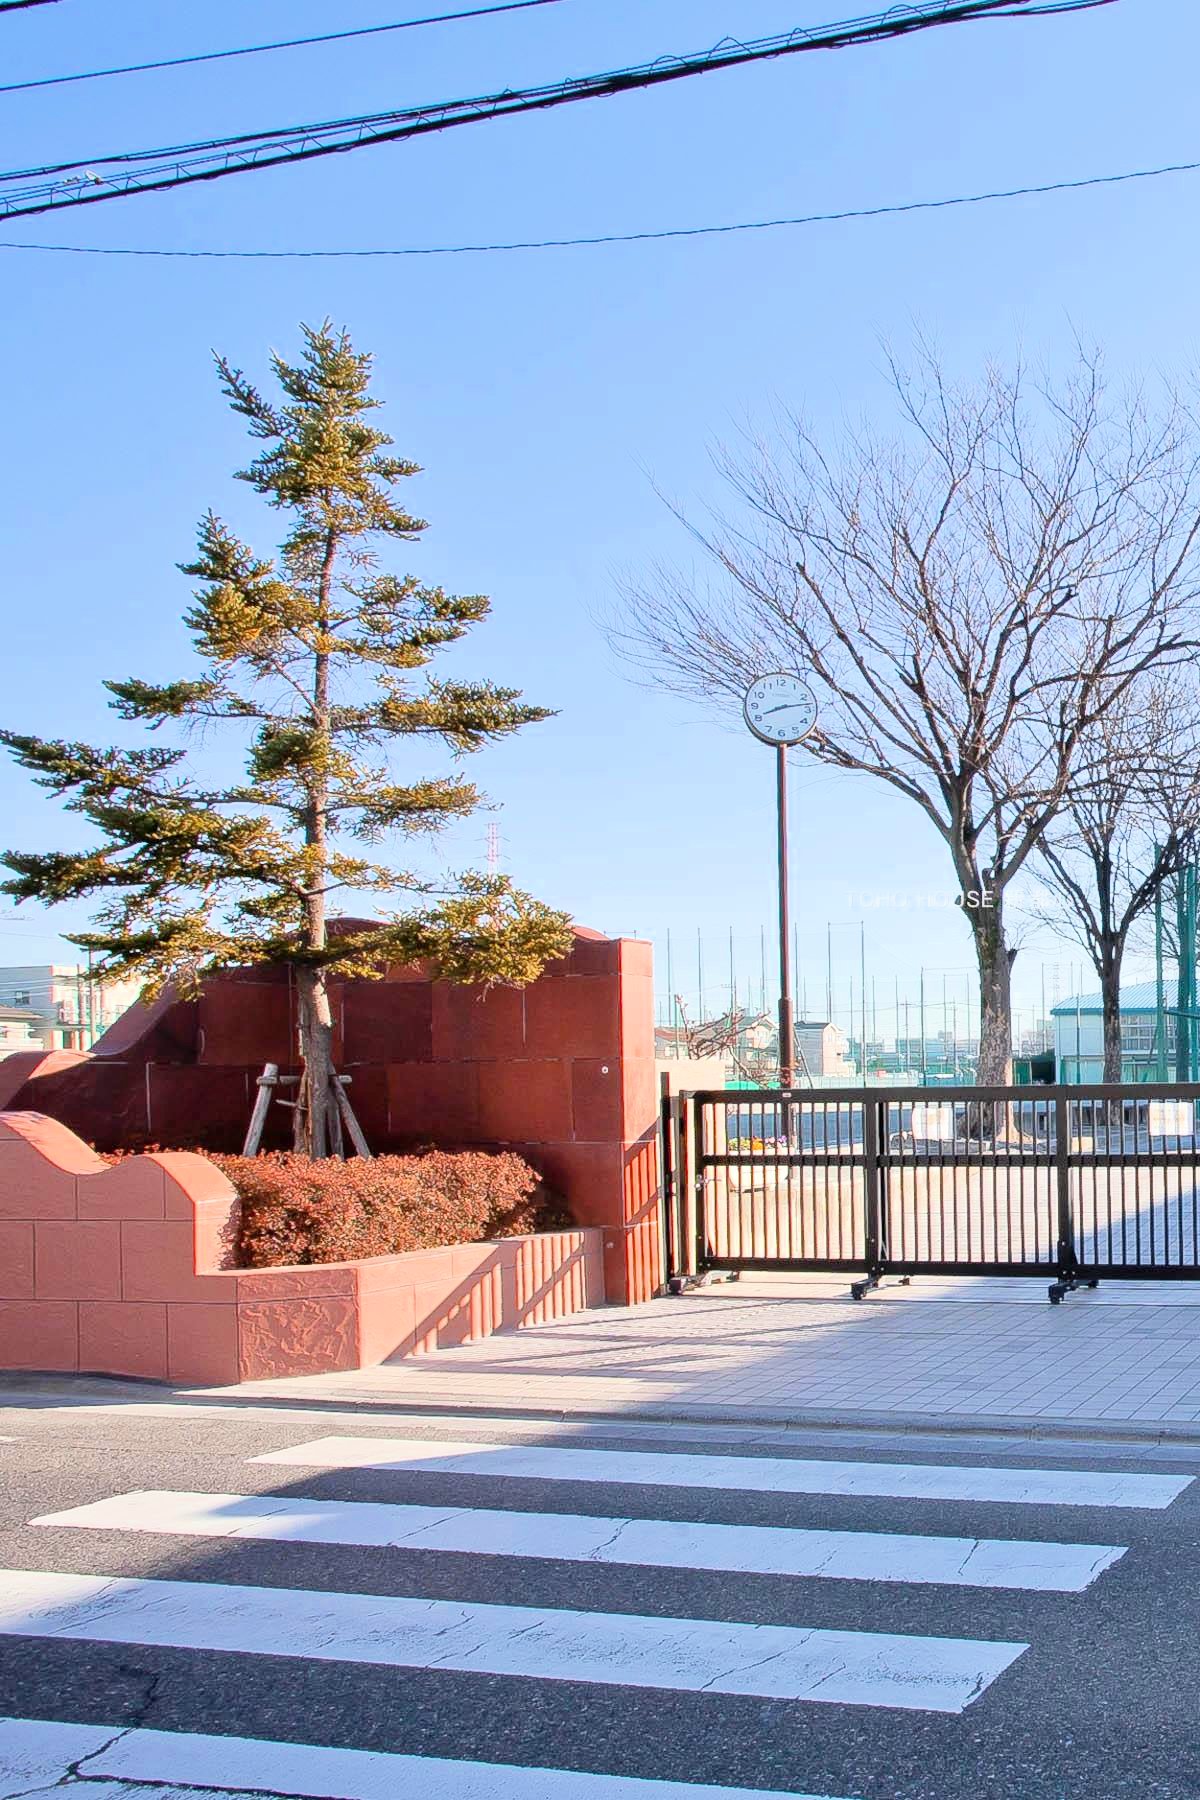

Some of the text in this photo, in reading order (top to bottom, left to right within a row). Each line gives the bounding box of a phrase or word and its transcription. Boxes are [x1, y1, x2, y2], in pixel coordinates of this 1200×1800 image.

[763, 682, 773, 690] 11
[776, 679, 786, 687] 12
[754, 691, 765, 699] 10
[800, 693, 808, 701] 2
[750, 702, 759, 710] 9
[754, 714, 763, 722] 8
[764, 725, 773, 733] 7
[777, 729, 786, 737] 6
[791, 726, 800, 734] 5
